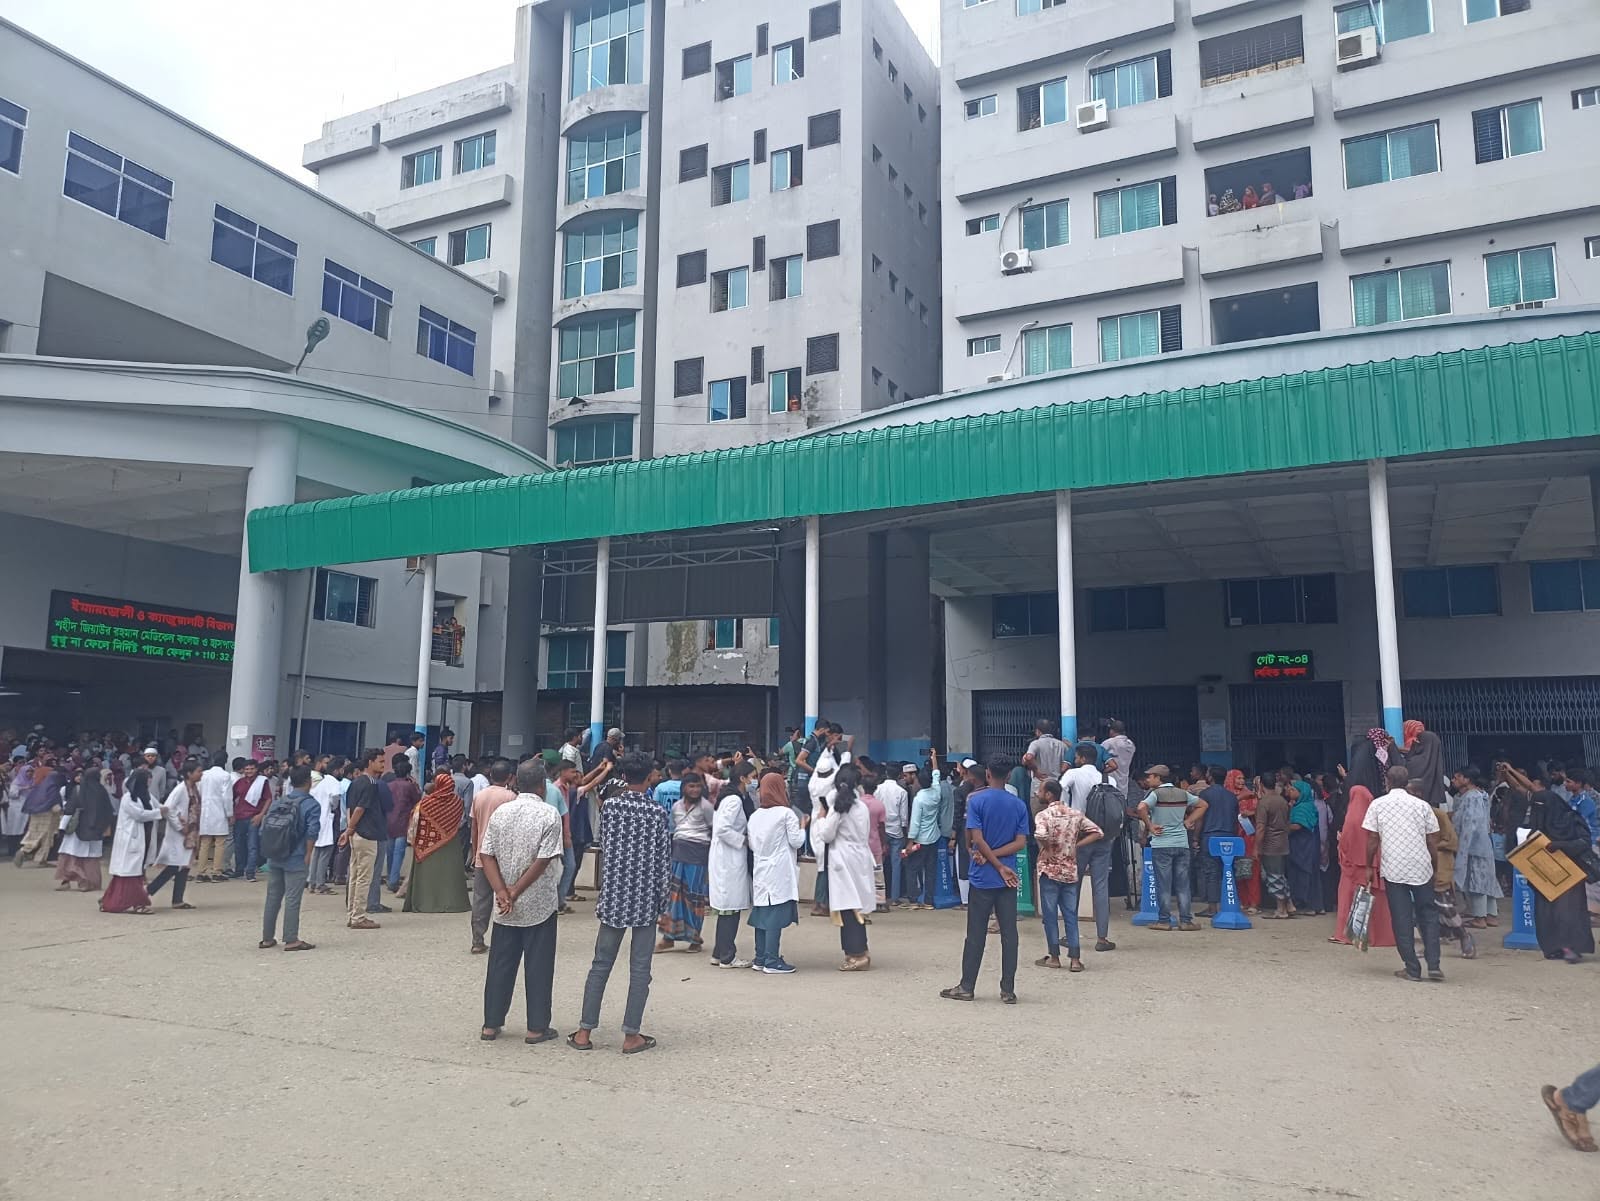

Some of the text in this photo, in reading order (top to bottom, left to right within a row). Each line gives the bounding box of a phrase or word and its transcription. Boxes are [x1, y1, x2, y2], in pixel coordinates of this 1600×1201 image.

[137, 610, 145, 621] ও
[55, 617, 78, 632] শহীদ
[80, 620, 112, 636] জিয়াউর
[113, 626, 139, 639] রহমান
[70, 637, 82, 648] না
[1256, 654, 1276, 665] গেট
[1149, 875, 1157, 907] SZMCH
[1226, 871, 1235, 905] SZMCH
[1522, 890, 1532, 926] SZMCH
